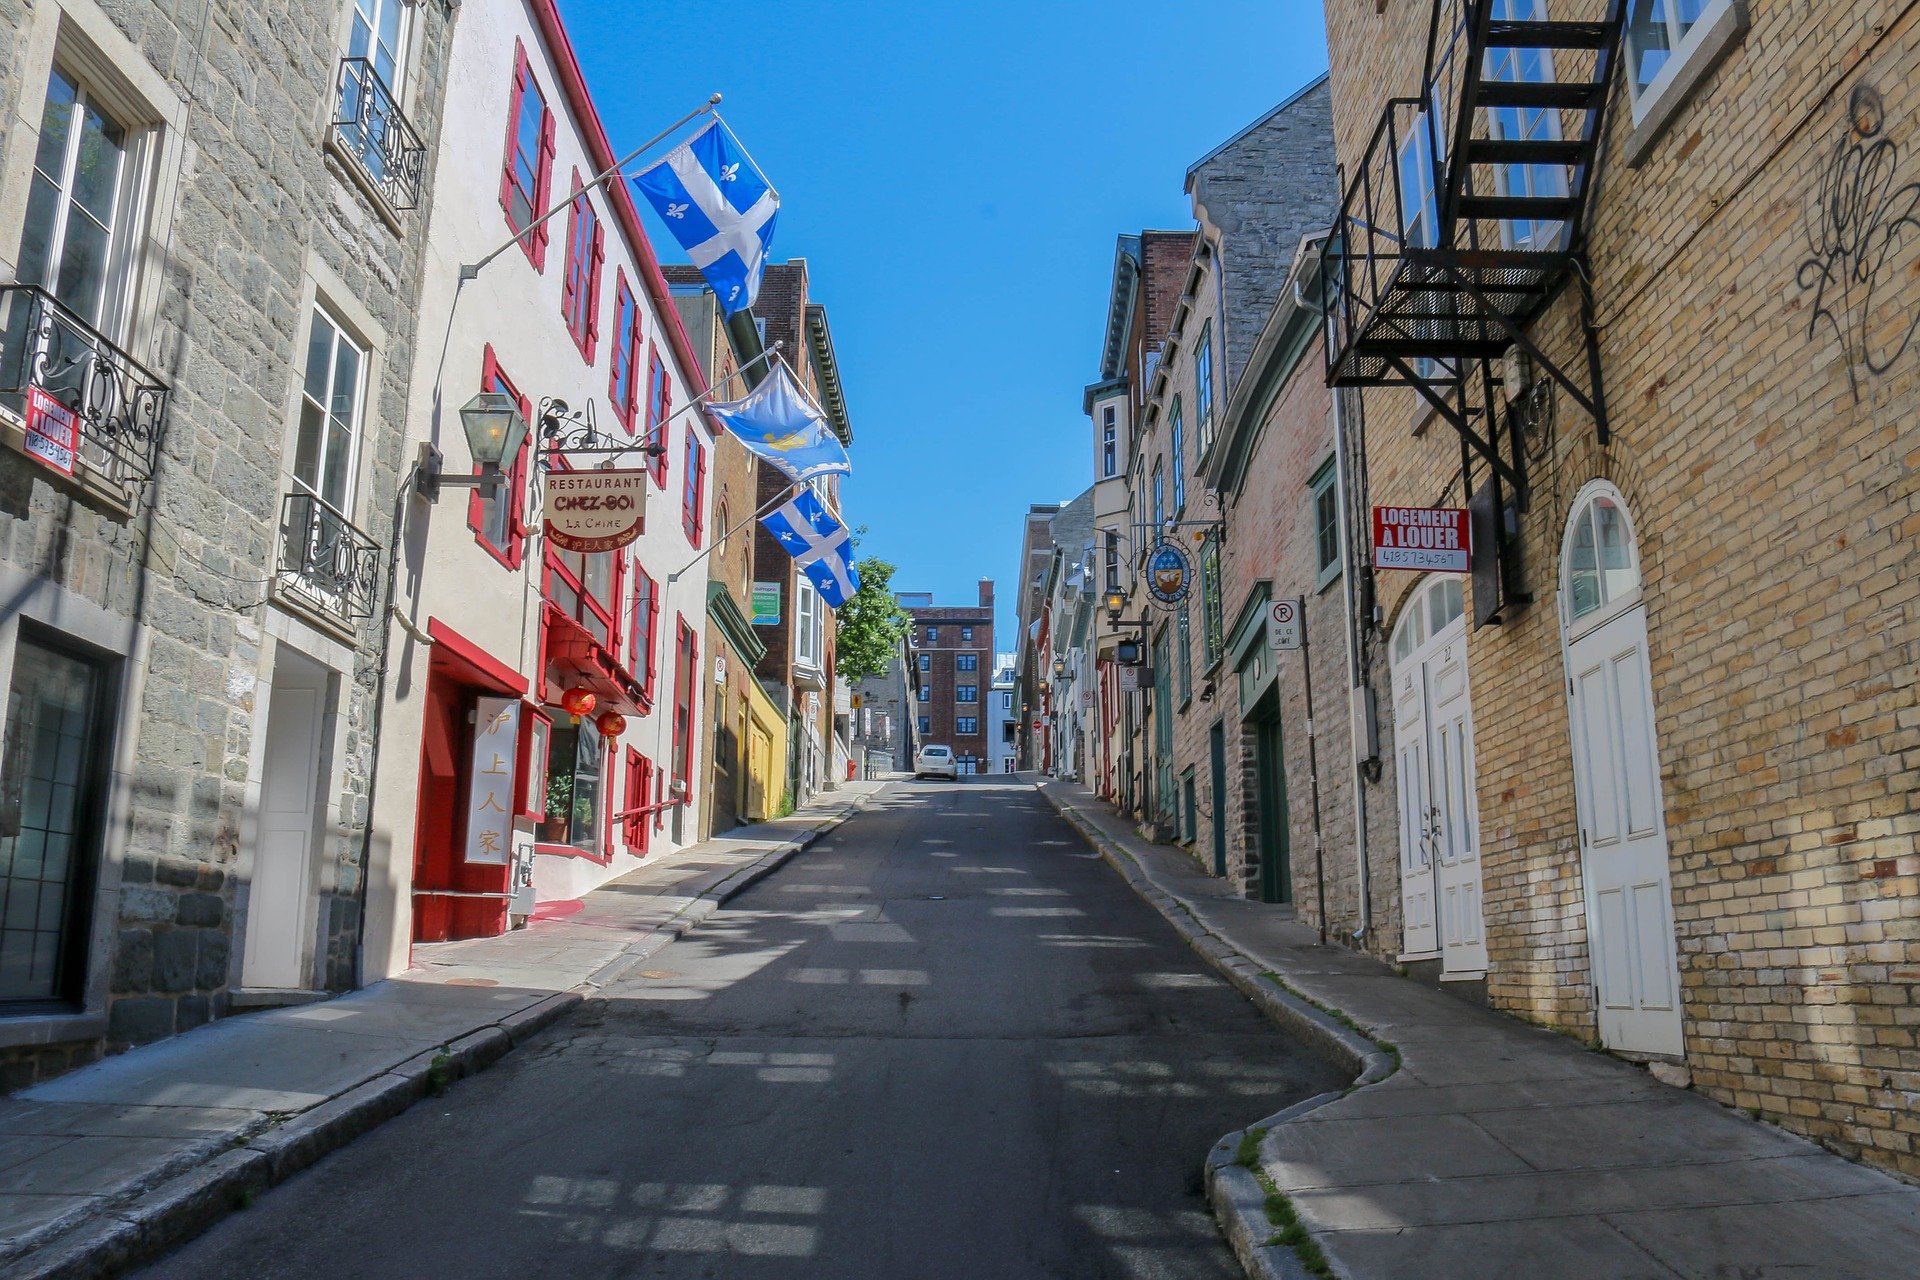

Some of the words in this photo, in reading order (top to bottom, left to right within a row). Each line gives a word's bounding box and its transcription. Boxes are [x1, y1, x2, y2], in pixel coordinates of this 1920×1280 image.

[33, 391, 75, 429] LOGEMENT
[40, 412, 72, 448] LOUER
[549, 478, 641, 490] RESTAURANT
[1381, 508, 1460, 527] LOGEMENT
[1382, 526, 1394, 547] À
[1397, 525, 1459, 549] LOUER
[478, 711, 512, 855] 沪上人家
